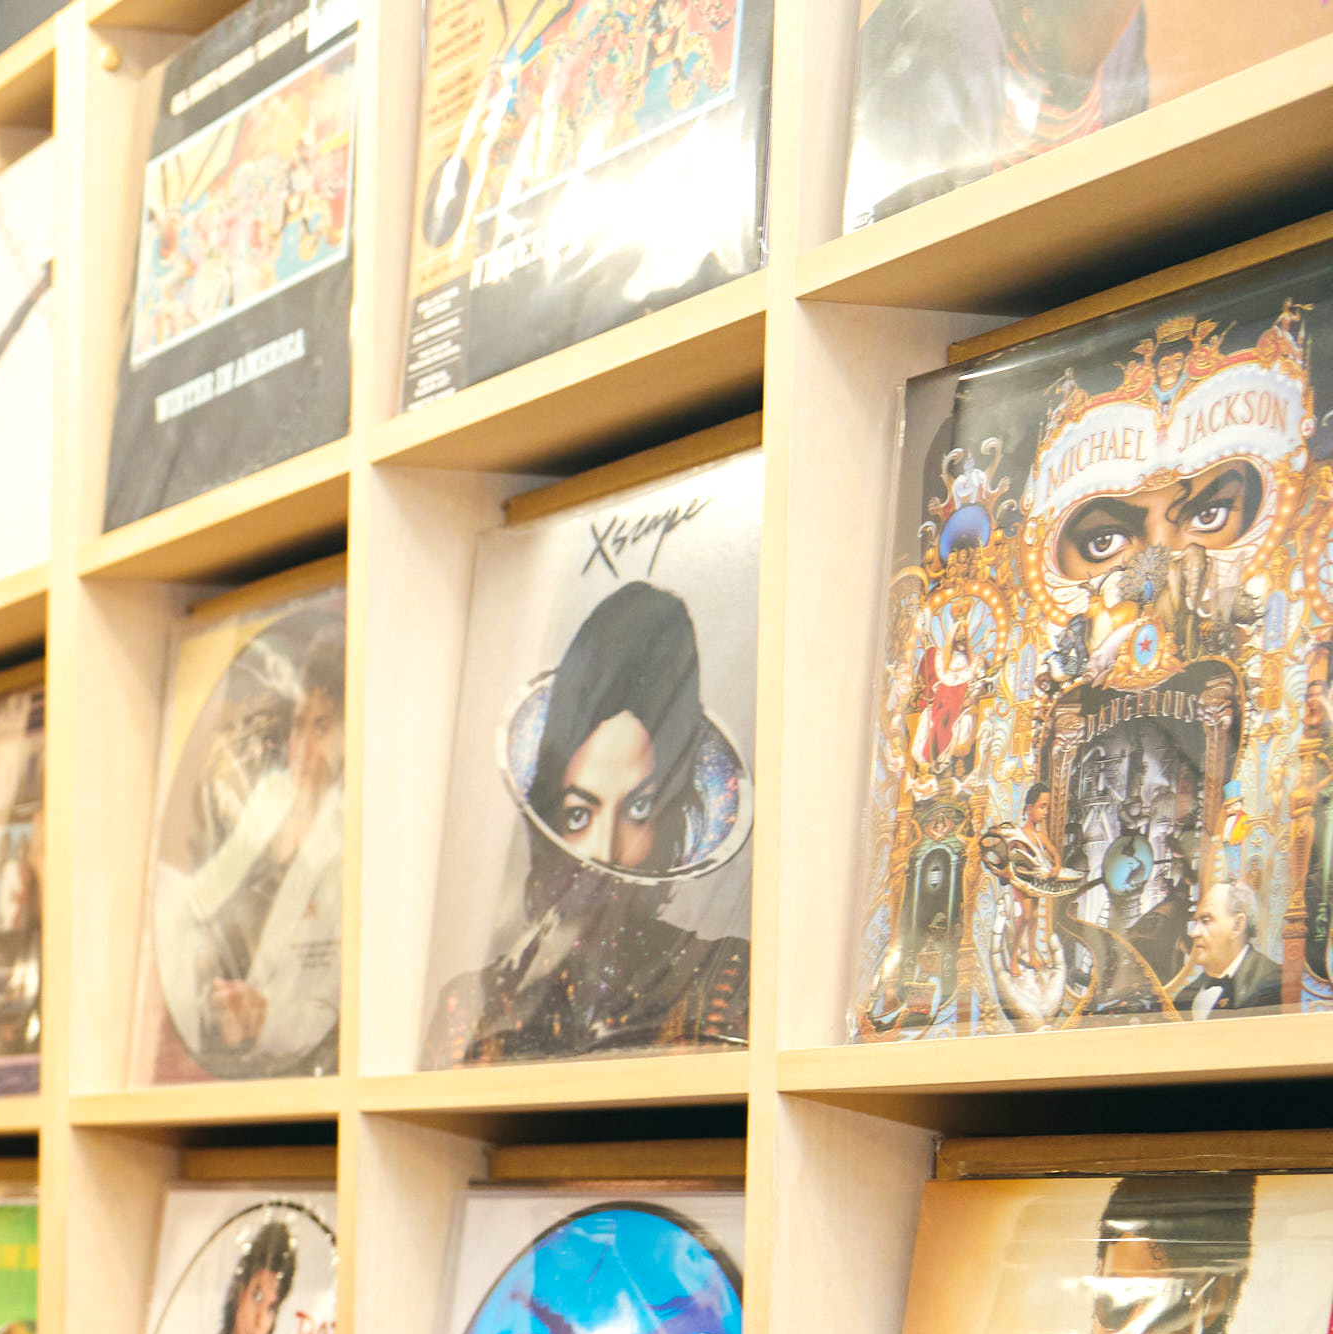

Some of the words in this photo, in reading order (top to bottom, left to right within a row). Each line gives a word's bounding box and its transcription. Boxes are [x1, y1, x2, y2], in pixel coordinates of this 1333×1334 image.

[1046, 427, 1148, 499] MICHAEL
[1178, 389, 1288, 452] JACKSON
[581, 497, 711, 578] Xscape
[1085, 689, 1197, 742] DANGEROUS
